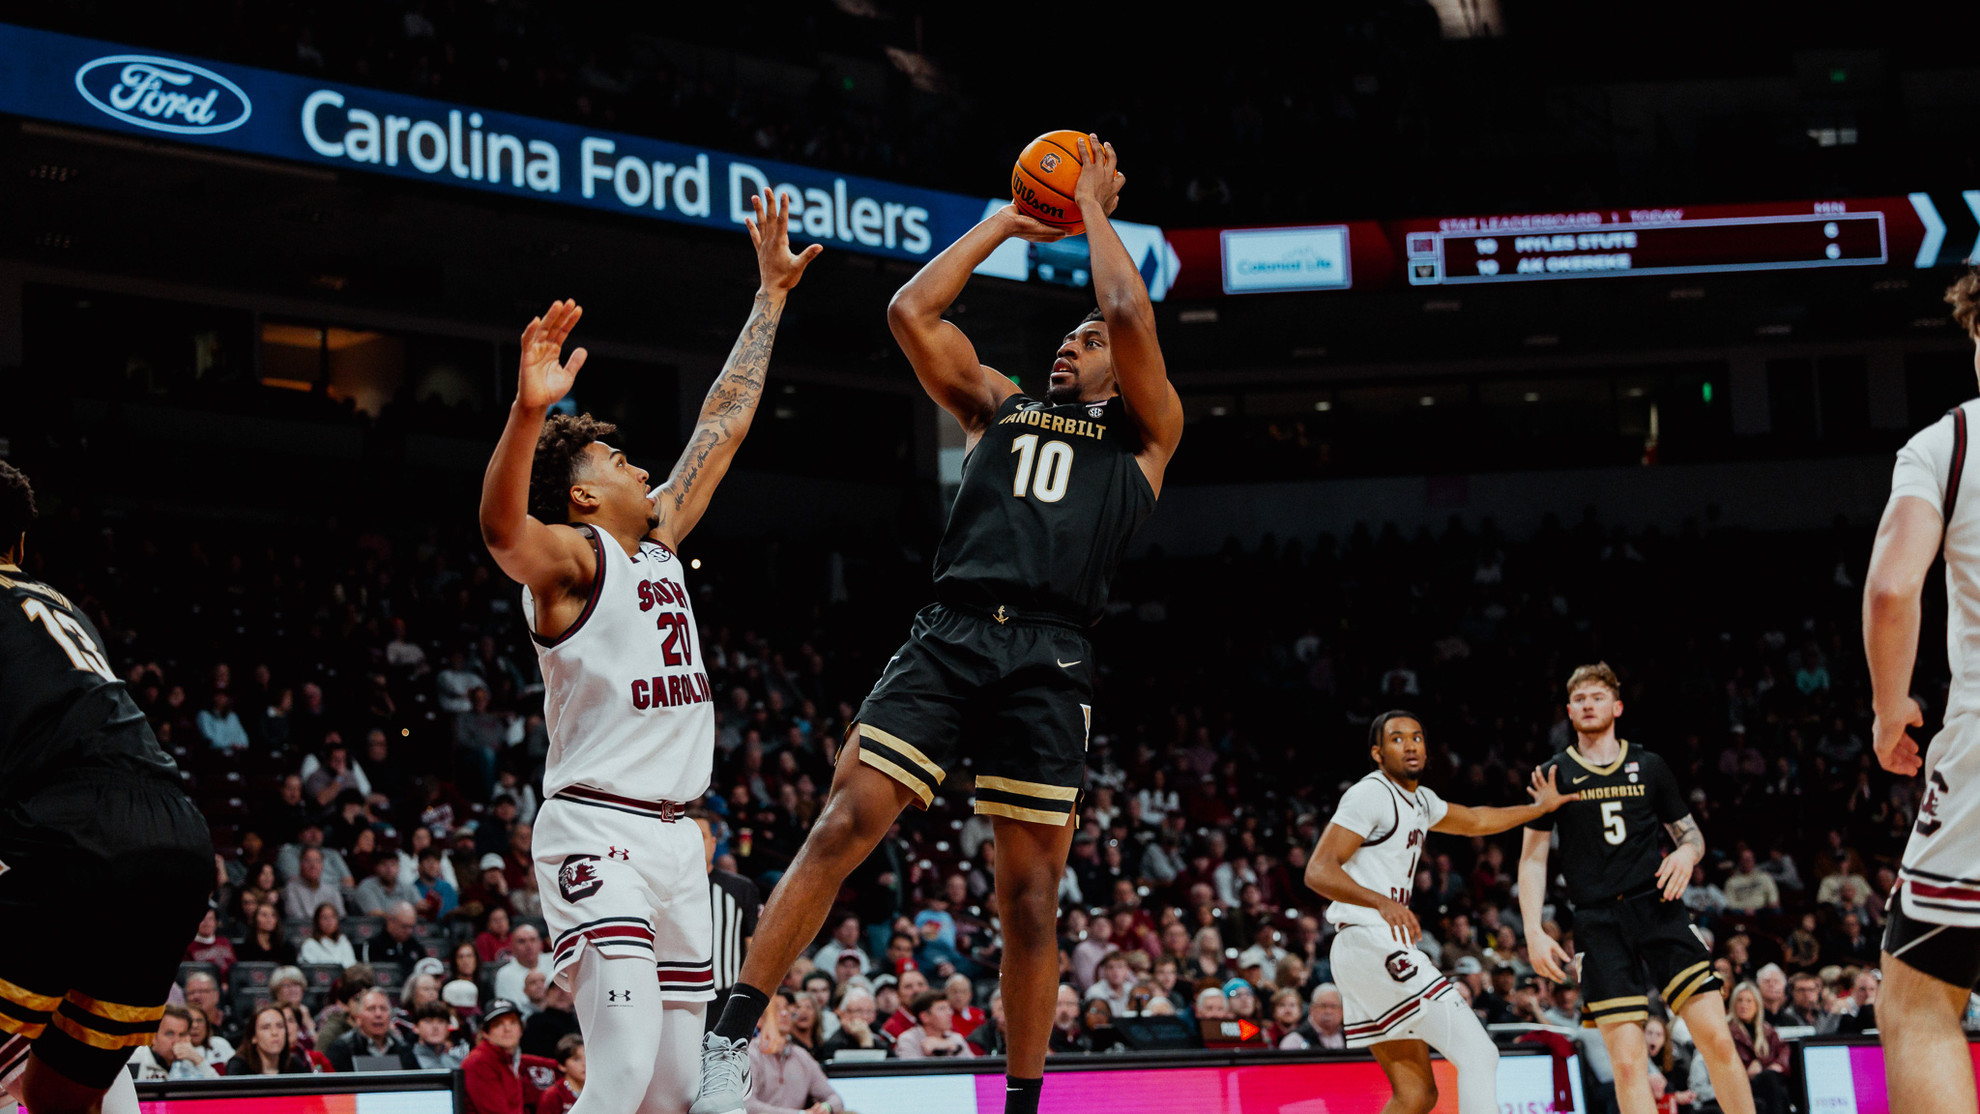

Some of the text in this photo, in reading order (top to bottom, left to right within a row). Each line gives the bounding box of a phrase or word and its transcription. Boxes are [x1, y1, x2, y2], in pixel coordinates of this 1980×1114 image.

[110, 64, 218, 125] Ford
[301, 89, 933, 255] Carolina Ford Dealers
[1012, 170, 1065, 219] Wilson
[1629, 208, 1684, 226] TODAY
[1010, 433, 1074, 503] 10
[21, 597, 119, 682] 13
[656, 611, 692, 667] 20
[1576, 784, 1646, 801] ANDERBILT
[1600, 801, 1627, 846] 5
